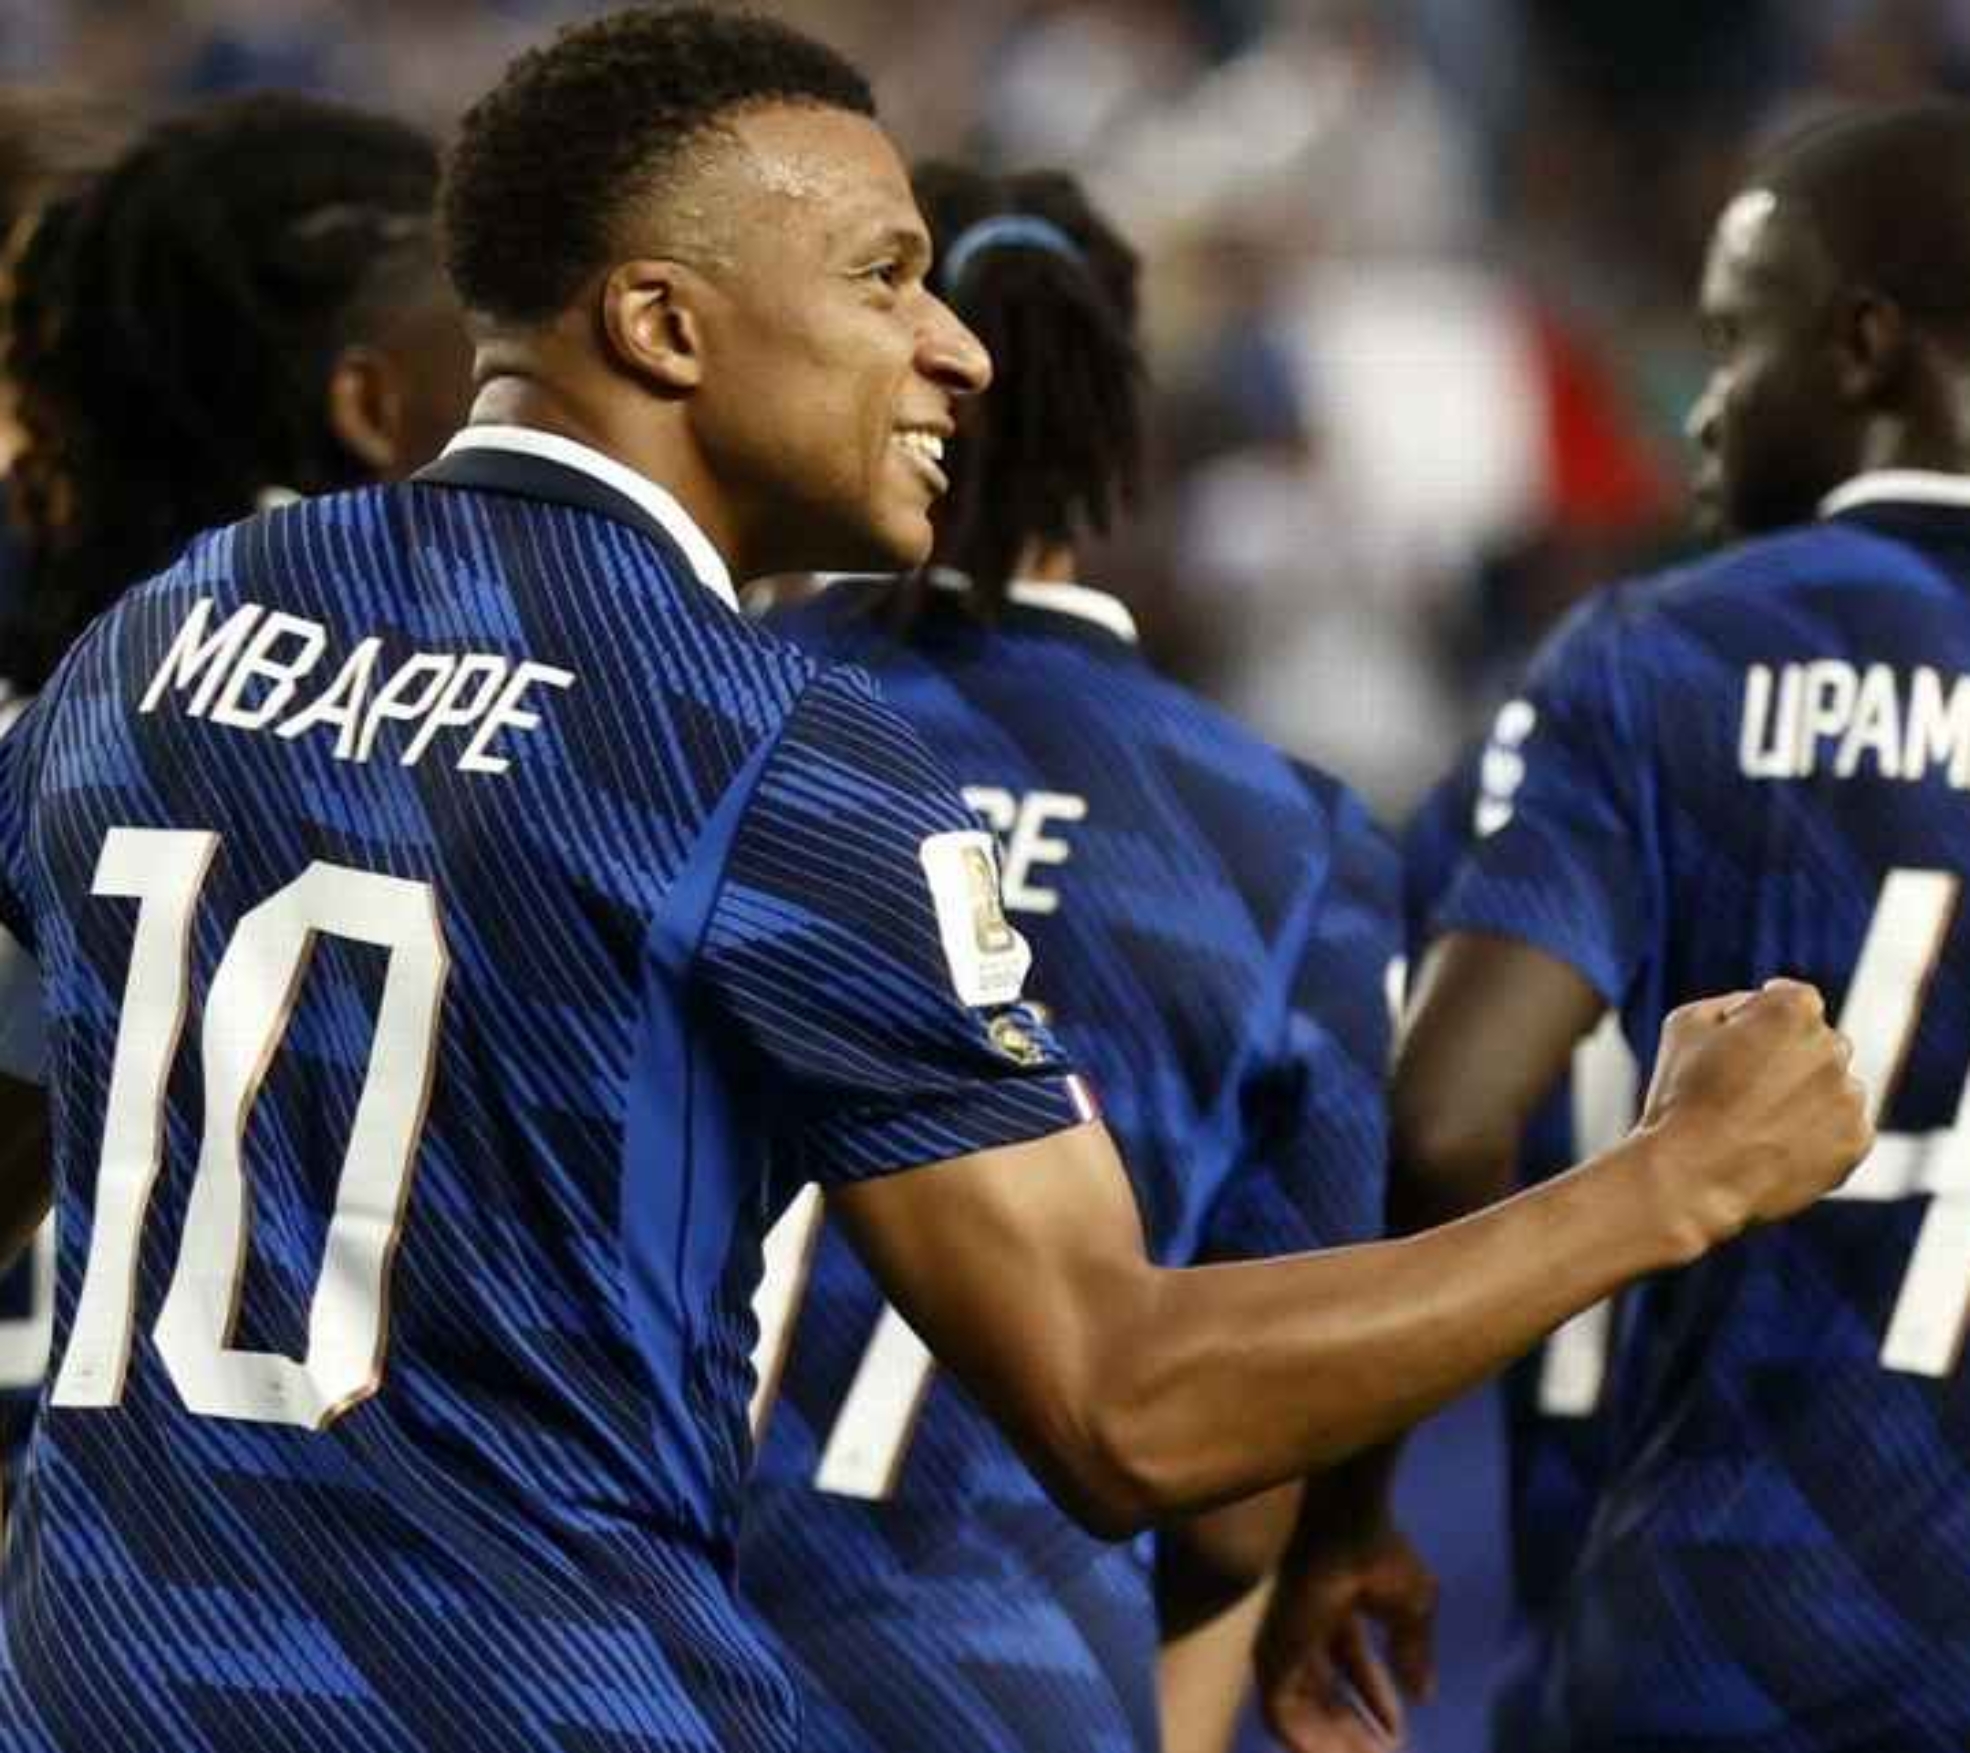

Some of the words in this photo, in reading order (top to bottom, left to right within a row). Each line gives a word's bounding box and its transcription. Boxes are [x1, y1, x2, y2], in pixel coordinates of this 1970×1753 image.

[138, 597, 575, 773] MBAPPE
[1740, 658, 1970, 790] UPAM
[51, 827, 450, 1430] 10
[1820, 867, 1970, 1377] 4
